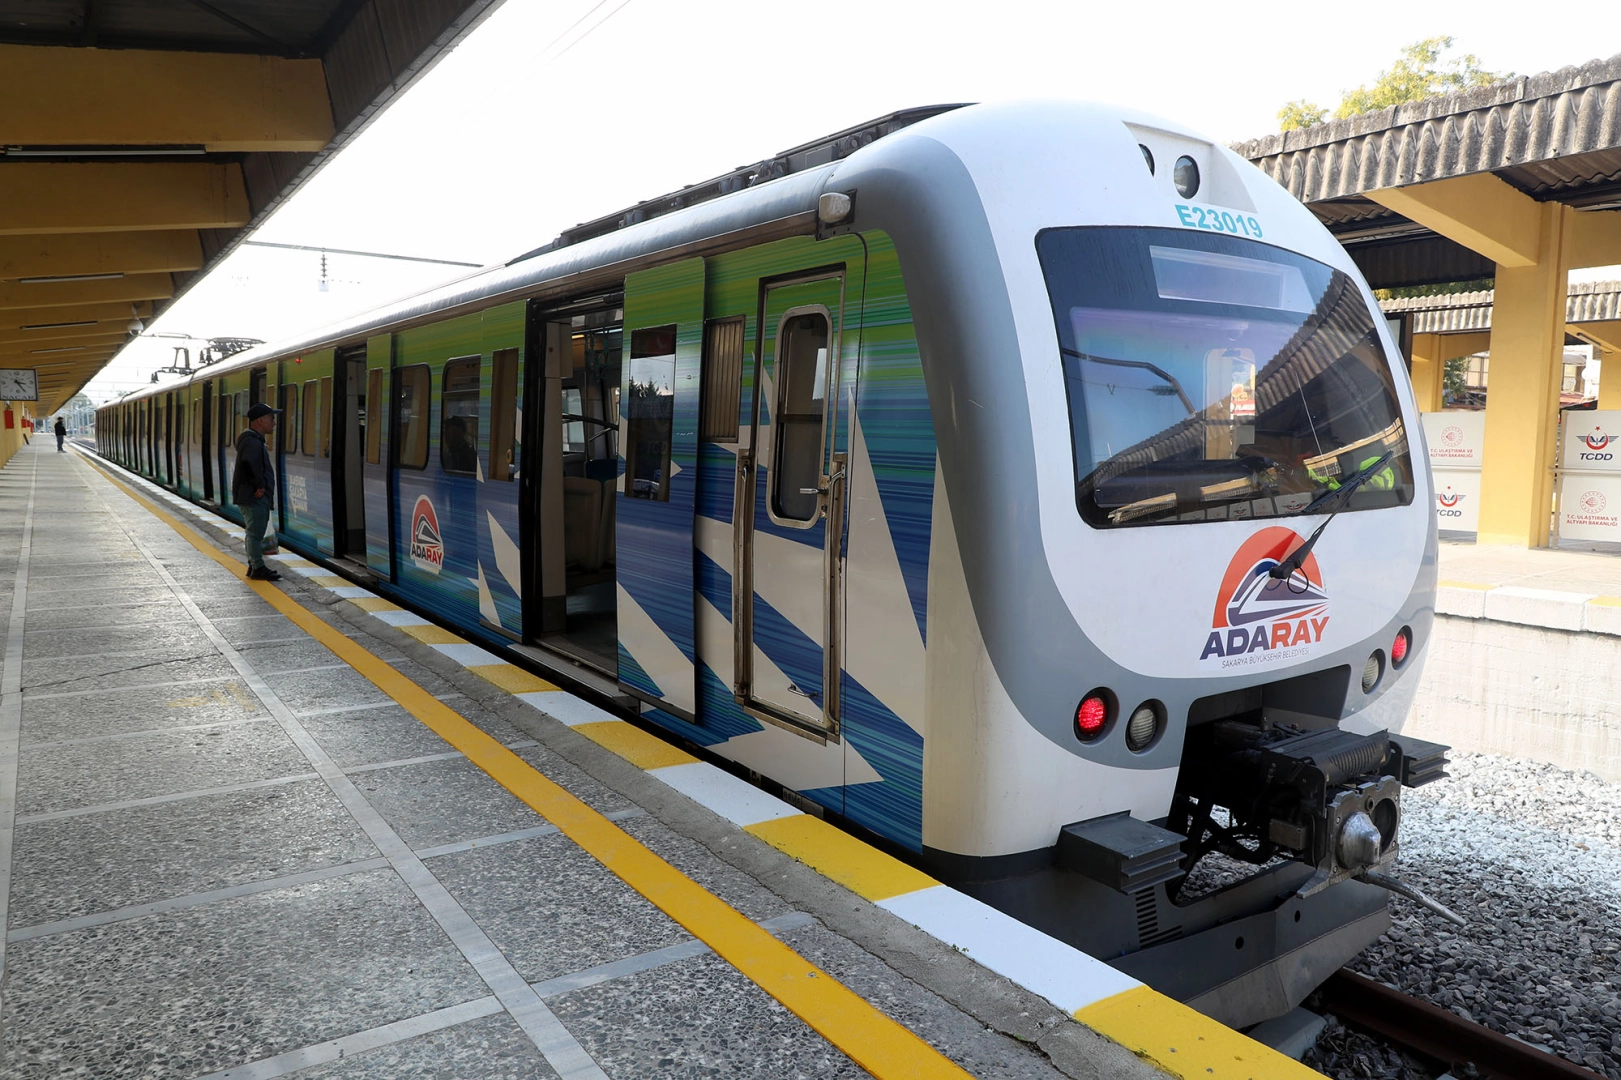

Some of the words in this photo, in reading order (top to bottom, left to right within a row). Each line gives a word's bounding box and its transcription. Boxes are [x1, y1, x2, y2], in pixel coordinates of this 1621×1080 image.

[1174, 204, 1263, 239] E23019
[1580, 452, 1614, 461] TCDD
[411, 543, 443, 566] ADARAY
[1199, 616, 1330, 660] ADARAY
[1222, 657, 1248, 669] SAKARYA
